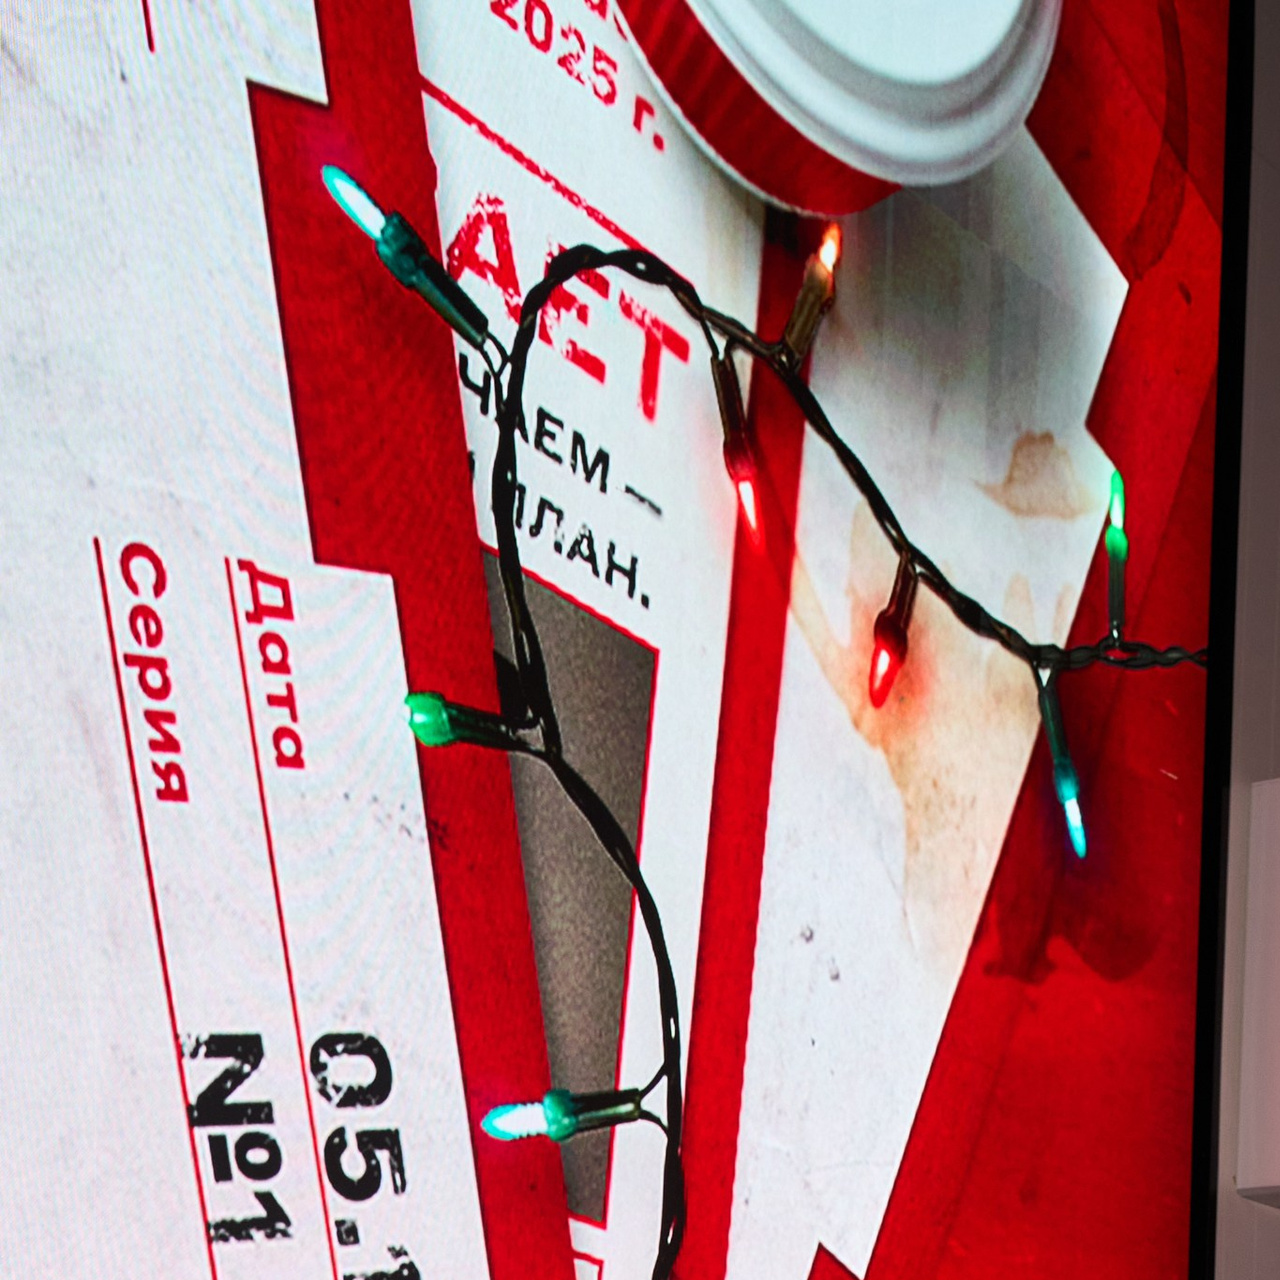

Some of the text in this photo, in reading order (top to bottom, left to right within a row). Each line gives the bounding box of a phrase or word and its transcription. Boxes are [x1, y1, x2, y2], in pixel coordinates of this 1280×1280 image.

[459, 352, 610, 495] ЧЕМ
[119, 541, 189, 803] Серия
[238, 558, 306, 771] Дата
[177, 1033, 293, 1243] №1
